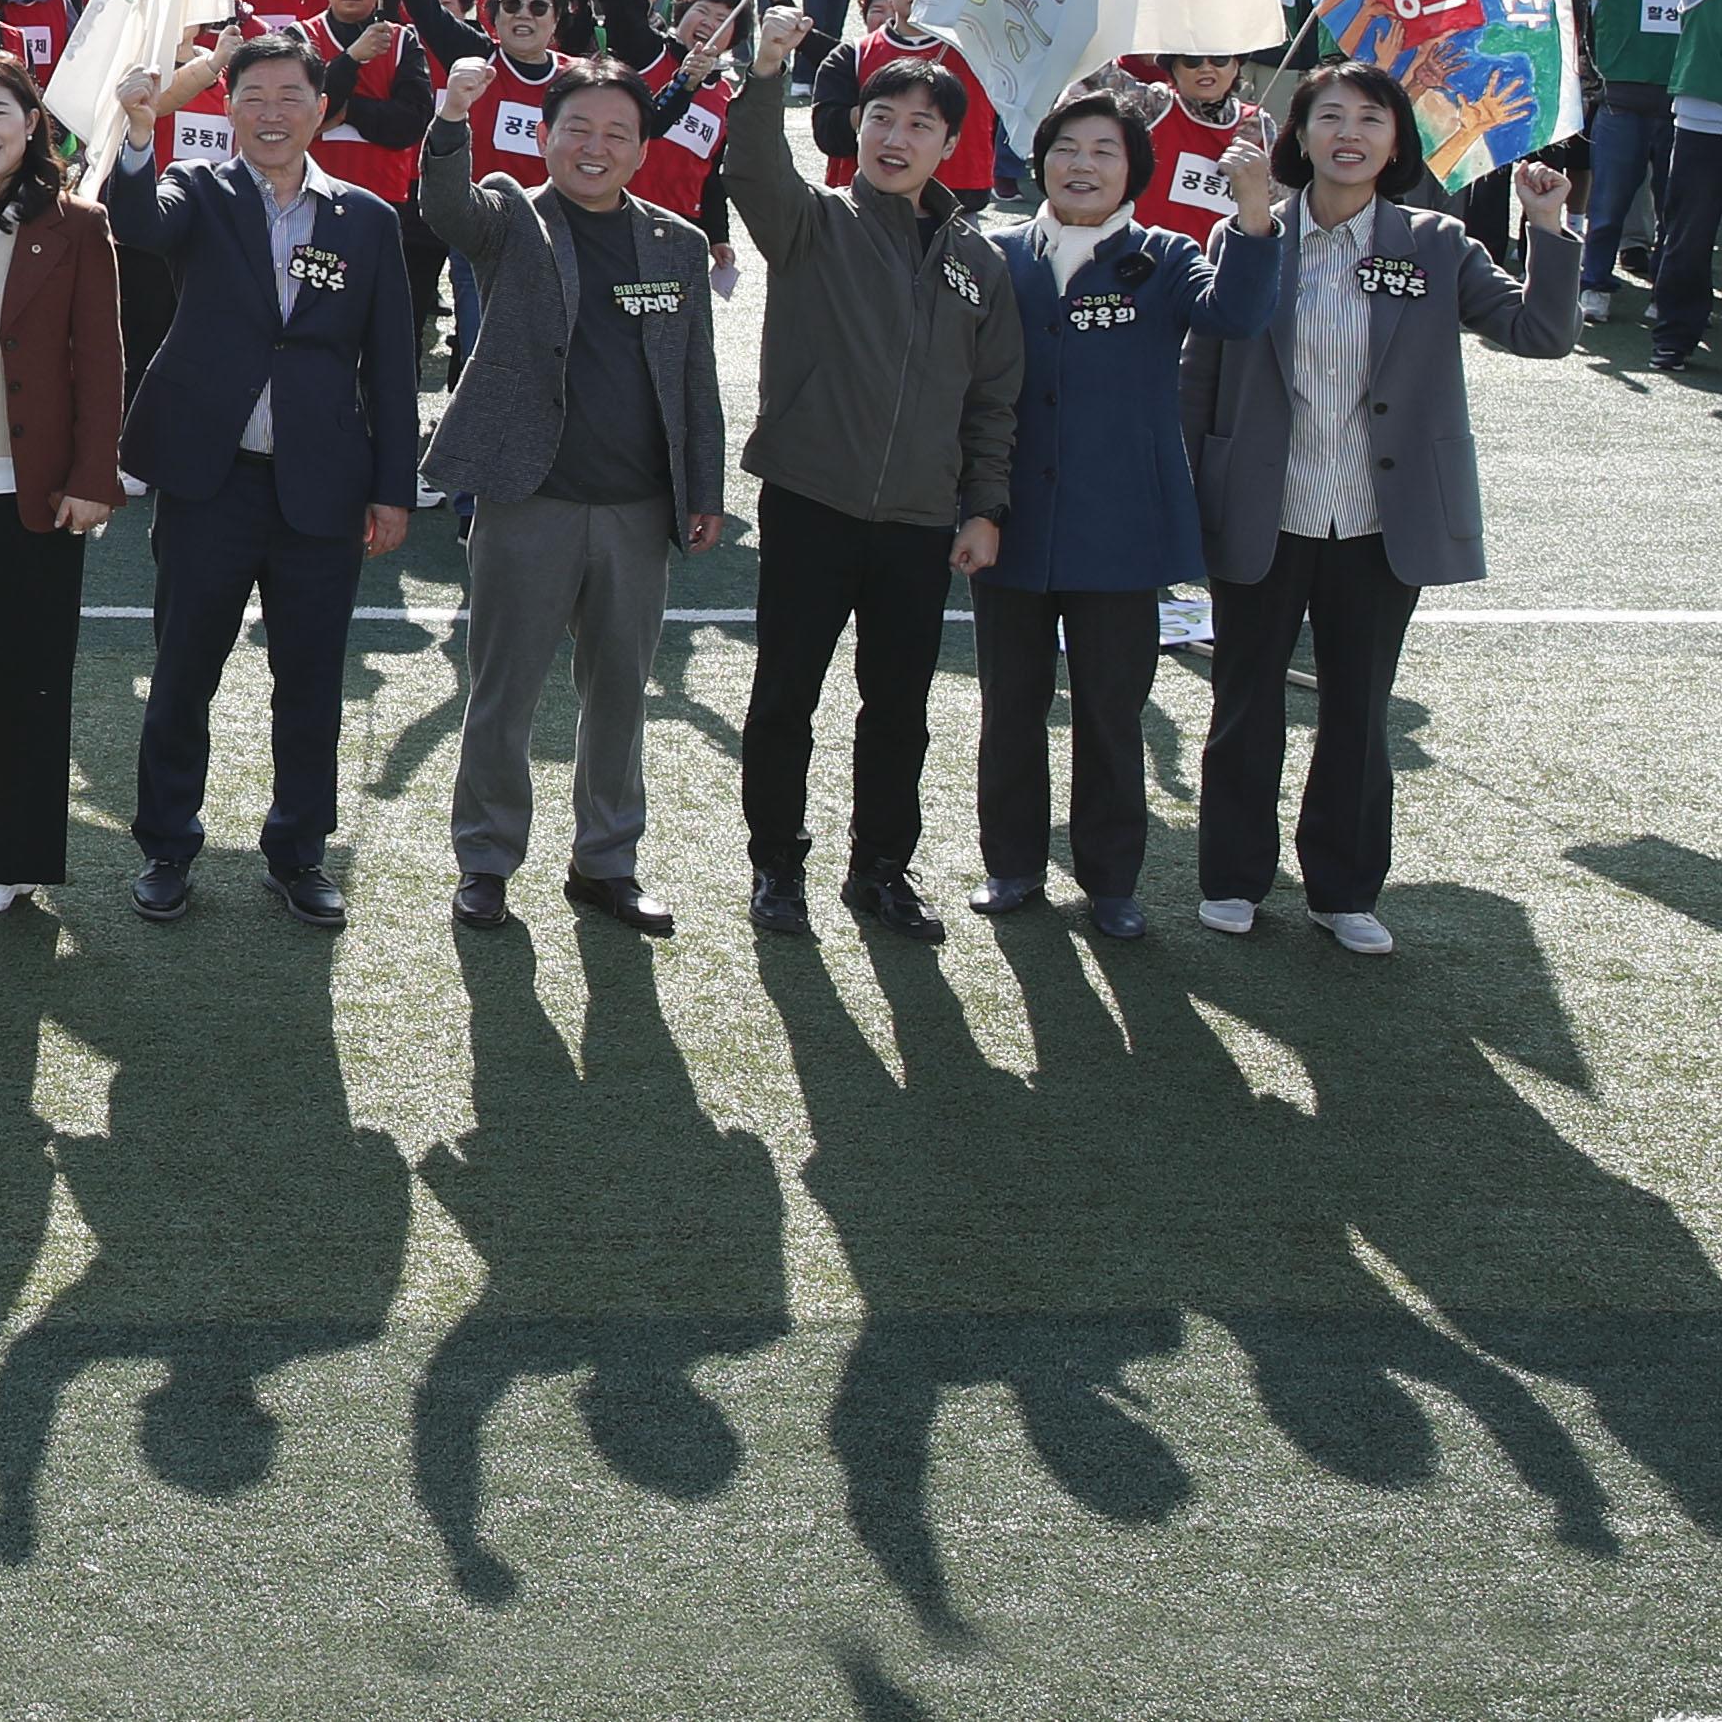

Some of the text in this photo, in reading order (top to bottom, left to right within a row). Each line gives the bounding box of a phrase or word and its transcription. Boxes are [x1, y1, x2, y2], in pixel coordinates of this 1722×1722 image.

[1647, 4, 1679, 21] 활성
[504, 115, 538, 137] 공동
[180, 127, 229, 151] 공동체
[305, 245, 339, 268] 부의장
[1373, 256, 1414, 273] 구의원
[289, 257, 346, 291] 오천수
[1357, 269, 1428, 297] 김현주
[1081, 293, 1121, 307] 구의원
[1070, 306, 1136, 330] 양옥희
